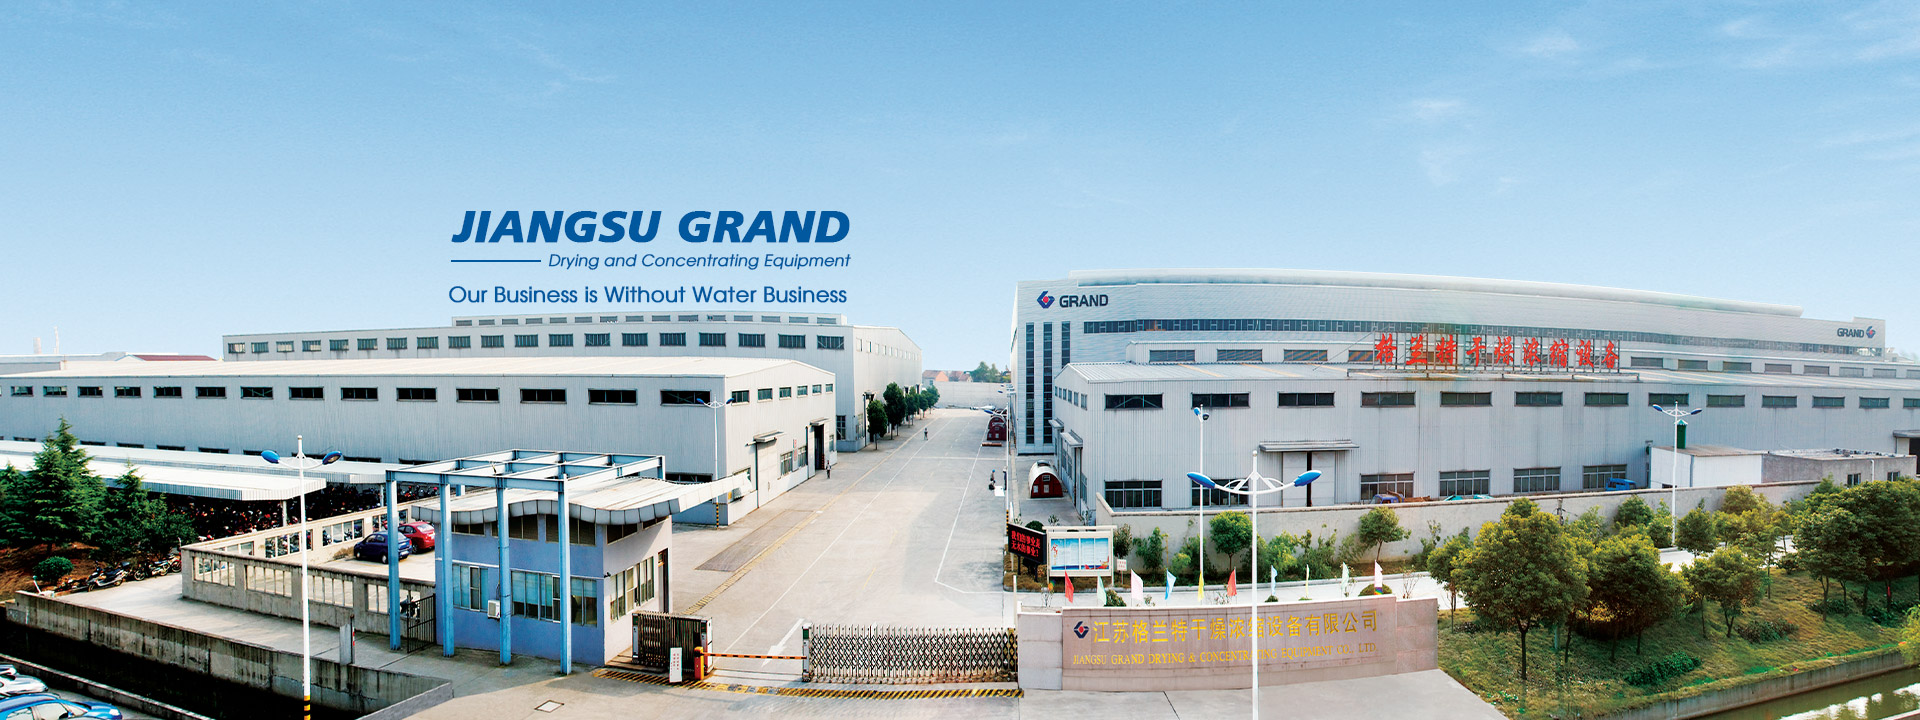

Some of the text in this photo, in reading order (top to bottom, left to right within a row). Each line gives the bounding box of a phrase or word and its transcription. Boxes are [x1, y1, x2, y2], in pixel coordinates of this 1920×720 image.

[1059, 294, 1109, 308] GRAND
[1836, 327, 1865, 338] GRAND
[1375, 333, 1619, 369] 格兰特干燥浓缩设备
[1093, 610, 1377, 644] 江苏格兰特干燥浓缩设备有限公司
[1073, 654, 1107, 665] JIANGSU
[1111, 654, 1145, 665] GRAND
[1148, 652, 1185, 665] DRYING
[1188, 652, 1197, 663] &
[1281, 646, 1333, 661] EQUIPMENT
